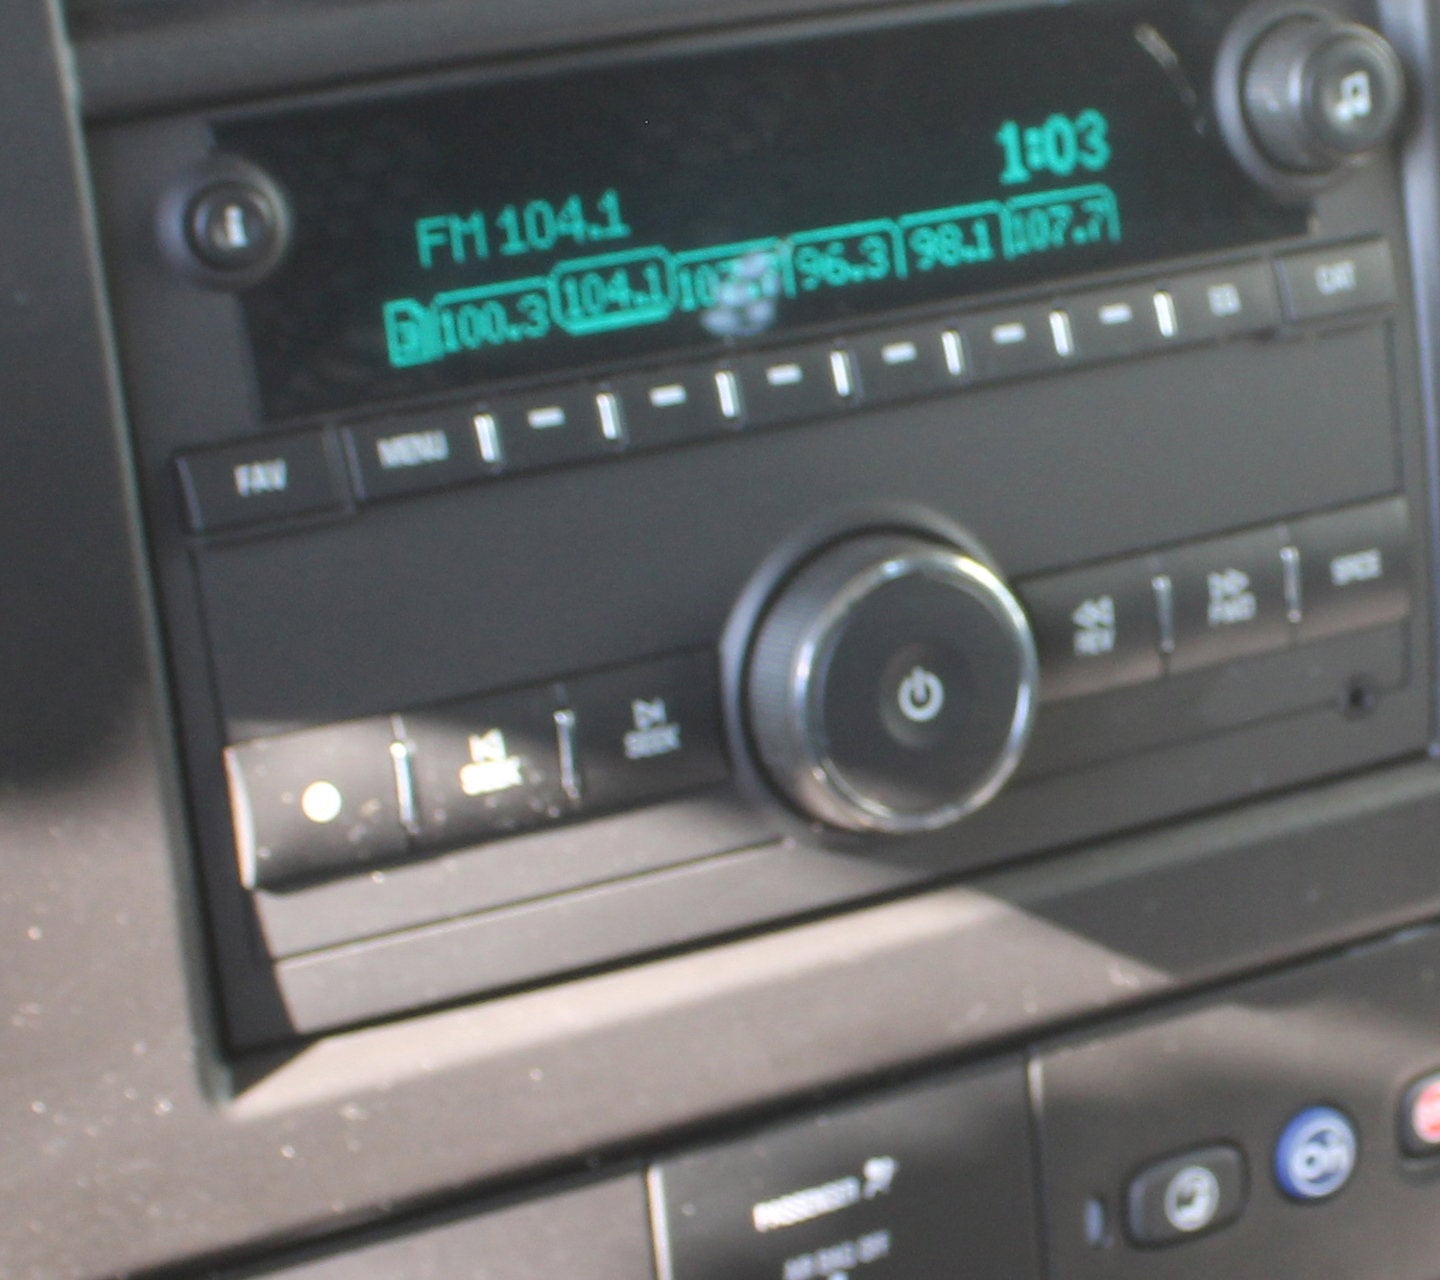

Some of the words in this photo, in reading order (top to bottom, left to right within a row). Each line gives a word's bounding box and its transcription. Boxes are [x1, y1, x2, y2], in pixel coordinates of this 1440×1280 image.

[995, 108, 1112, 186] 1:03
[415, 213, 489, 269] FM
[496, 188, 632, 257] 104.1
[440, 292, 552, 355] 100.3
[562, 261, 663, 320] 104.1
[909, 217, 997, 272] 98.1
